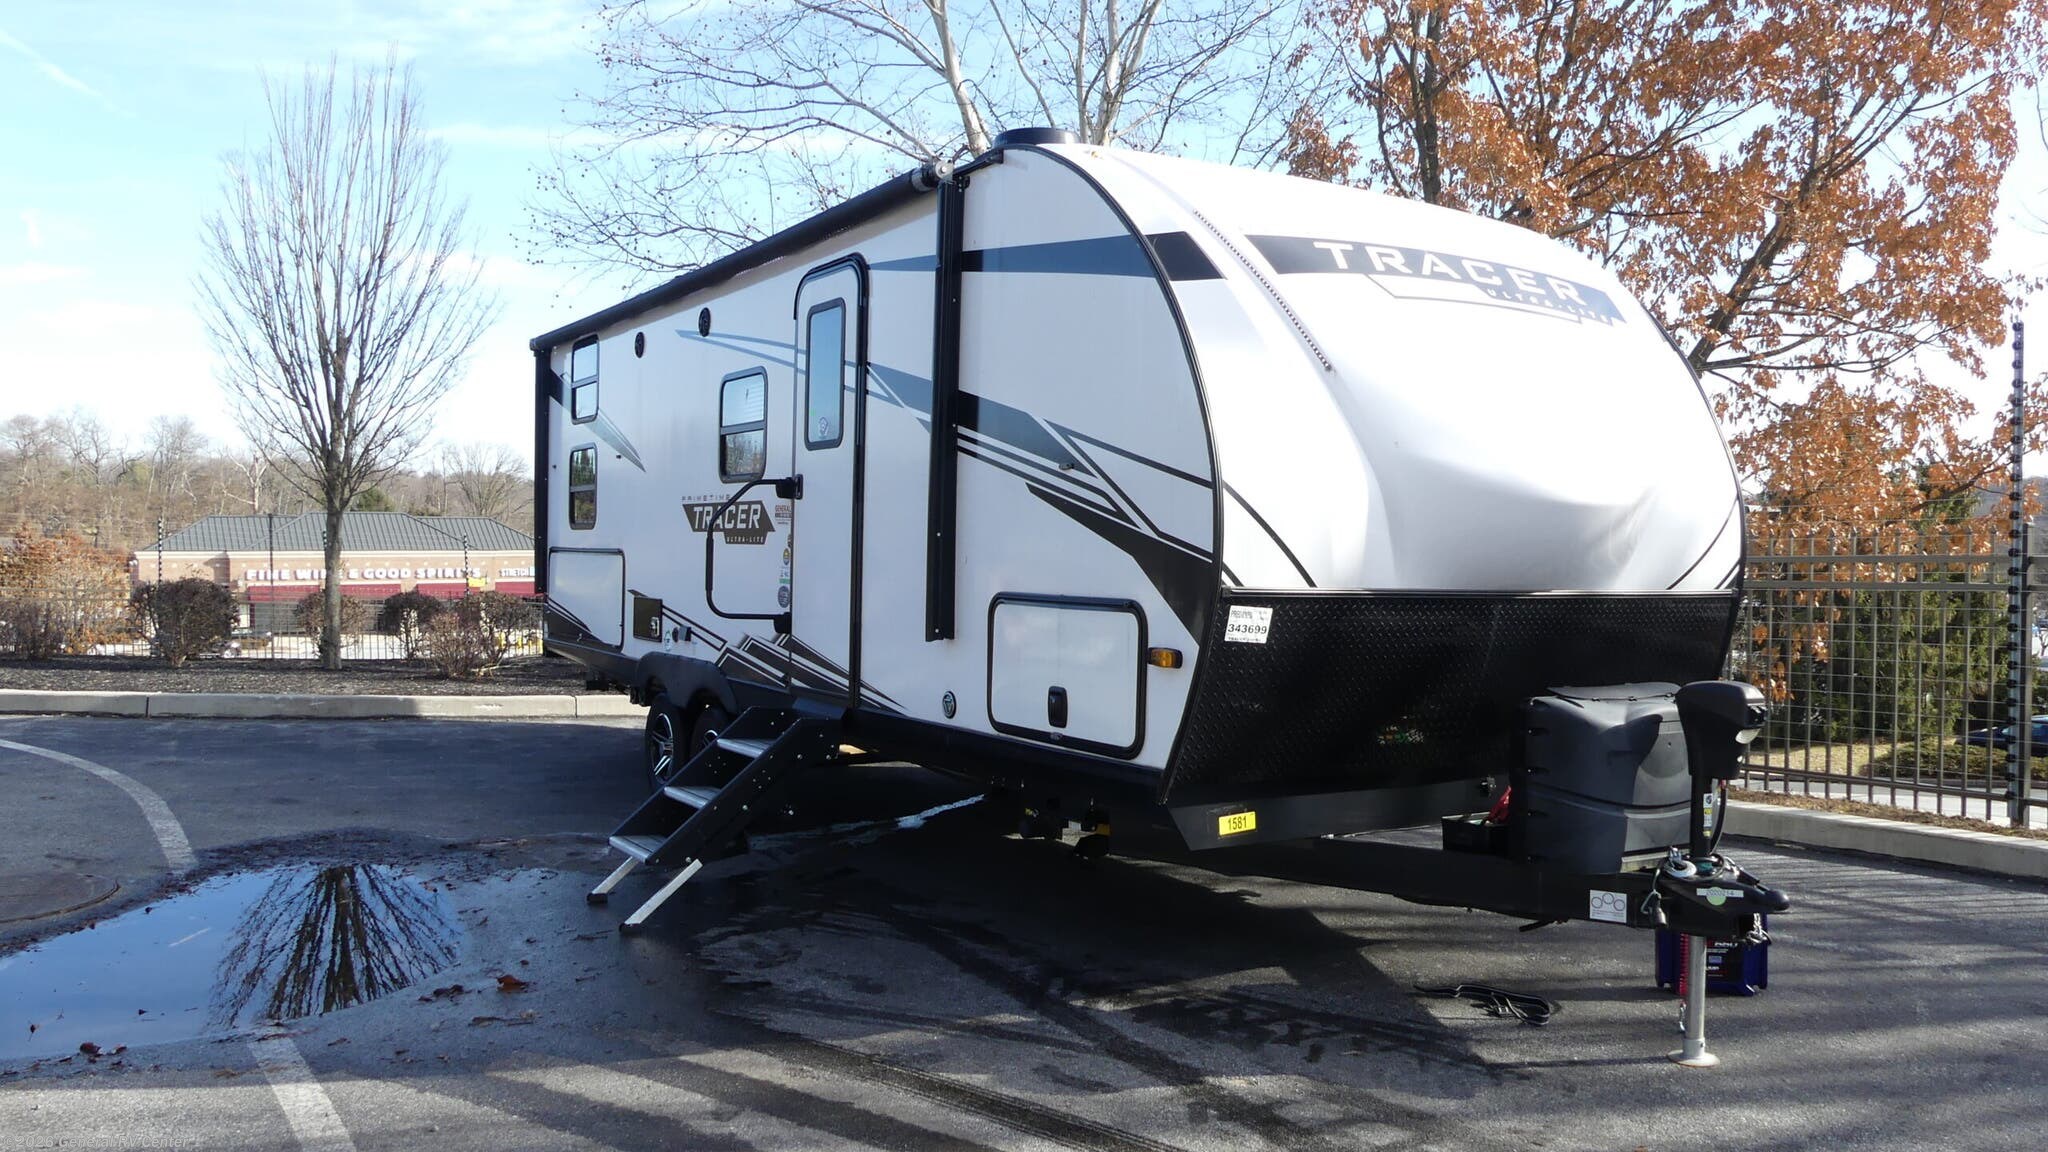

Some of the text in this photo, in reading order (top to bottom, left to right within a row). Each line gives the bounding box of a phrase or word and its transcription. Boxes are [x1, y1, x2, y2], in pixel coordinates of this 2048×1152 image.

[1313, 241, 1588, 306] TRACER
[1486, 288, 1609, 323] ULTRA-LITE
[693, 504, 761, 529] TRACER
[246, 568, 290, 580] FINE
[363, 567, 412, 579] GOOD
[1227, 623, 1268, 635] 343699
[1228, 815, 1247, 831] 1581
